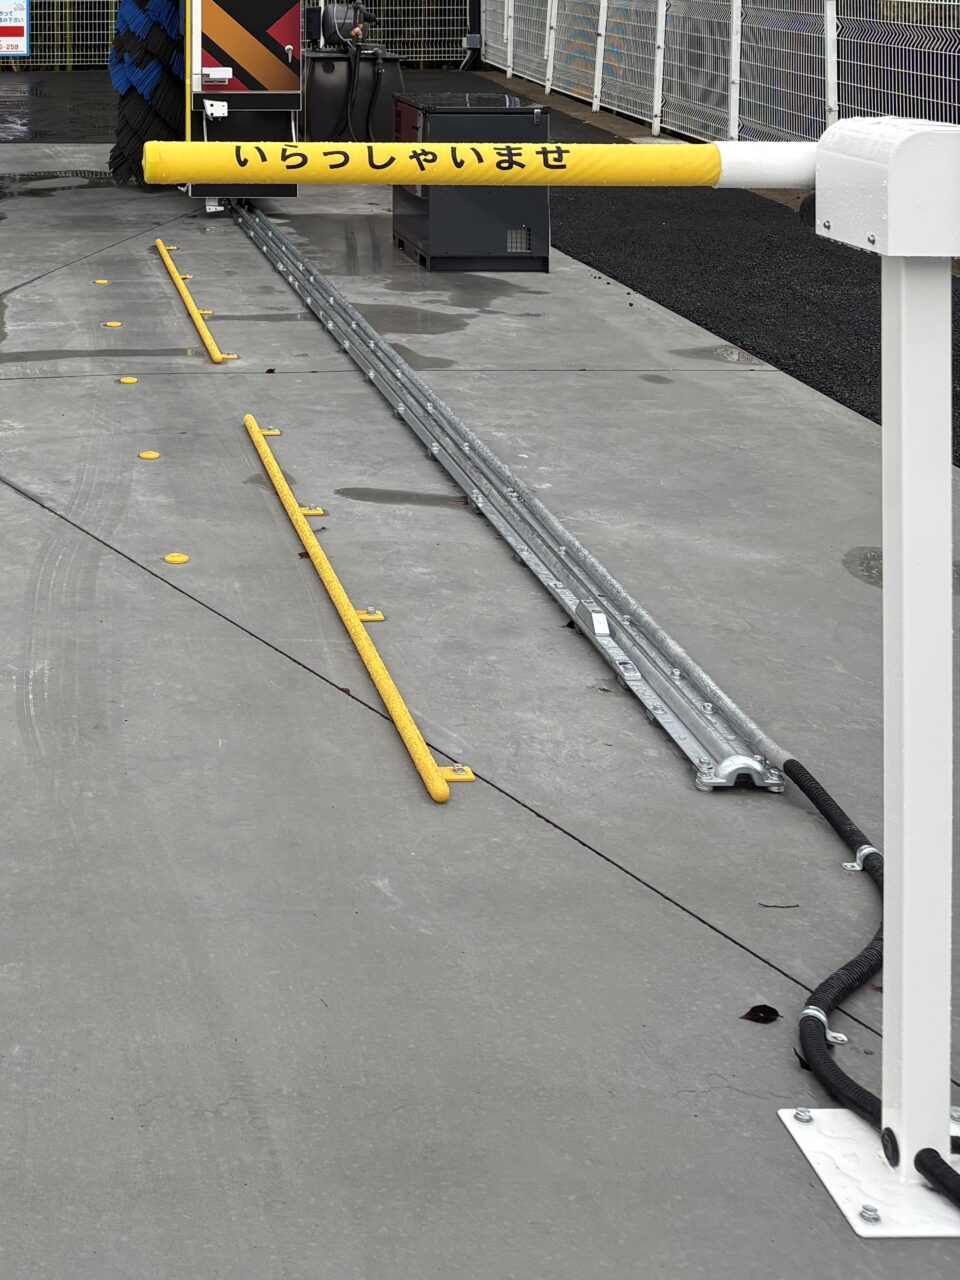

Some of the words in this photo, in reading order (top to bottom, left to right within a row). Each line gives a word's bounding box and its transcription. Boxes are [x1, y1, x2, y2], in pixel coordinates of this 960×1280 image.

[234, 143, 571, 172] いらっしゃいませ
